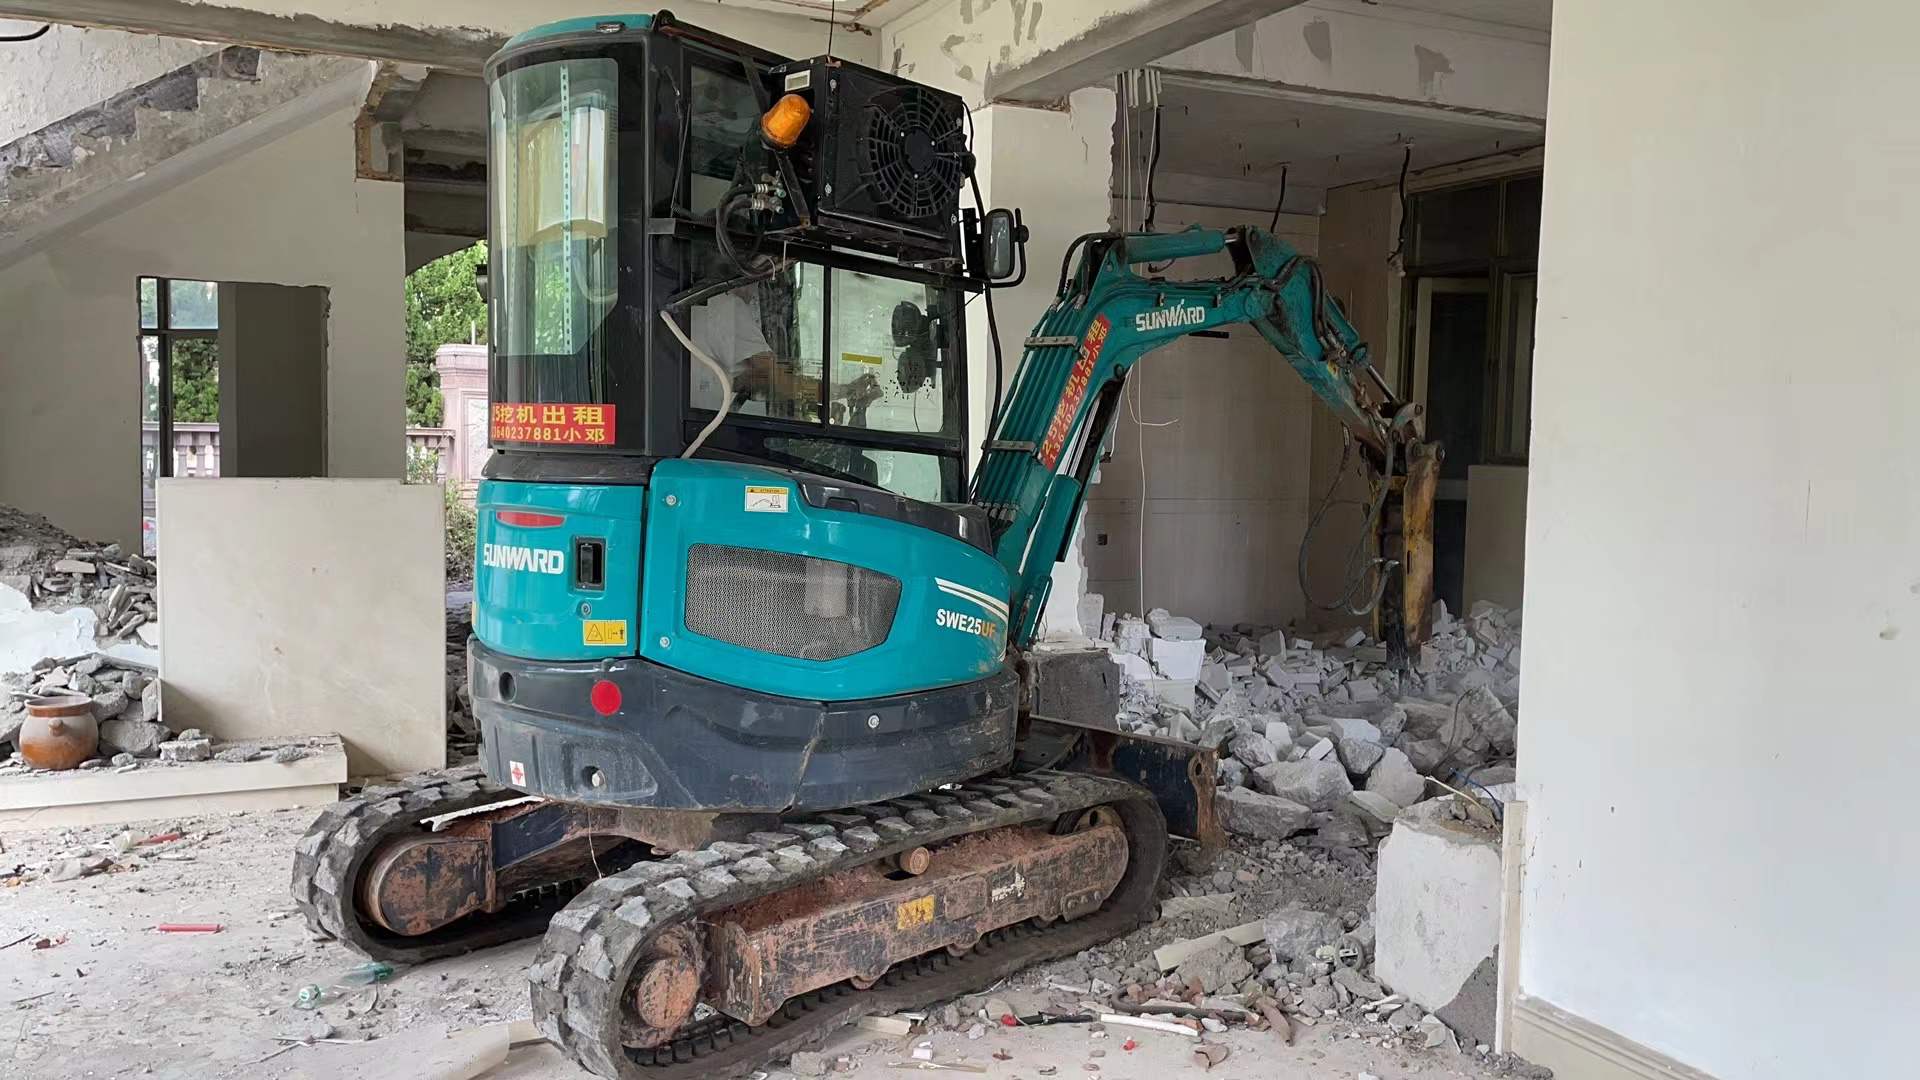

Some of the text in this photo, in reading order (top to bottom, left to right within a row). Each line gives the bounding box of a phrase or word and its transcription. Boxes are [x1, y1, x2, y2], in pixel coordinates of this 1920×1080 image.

[1135, 299, 1205, 332] SUNWARD
[483, 543, 565, 575] SUNWARD
[935, 608, 997, 637] SWE25UF
